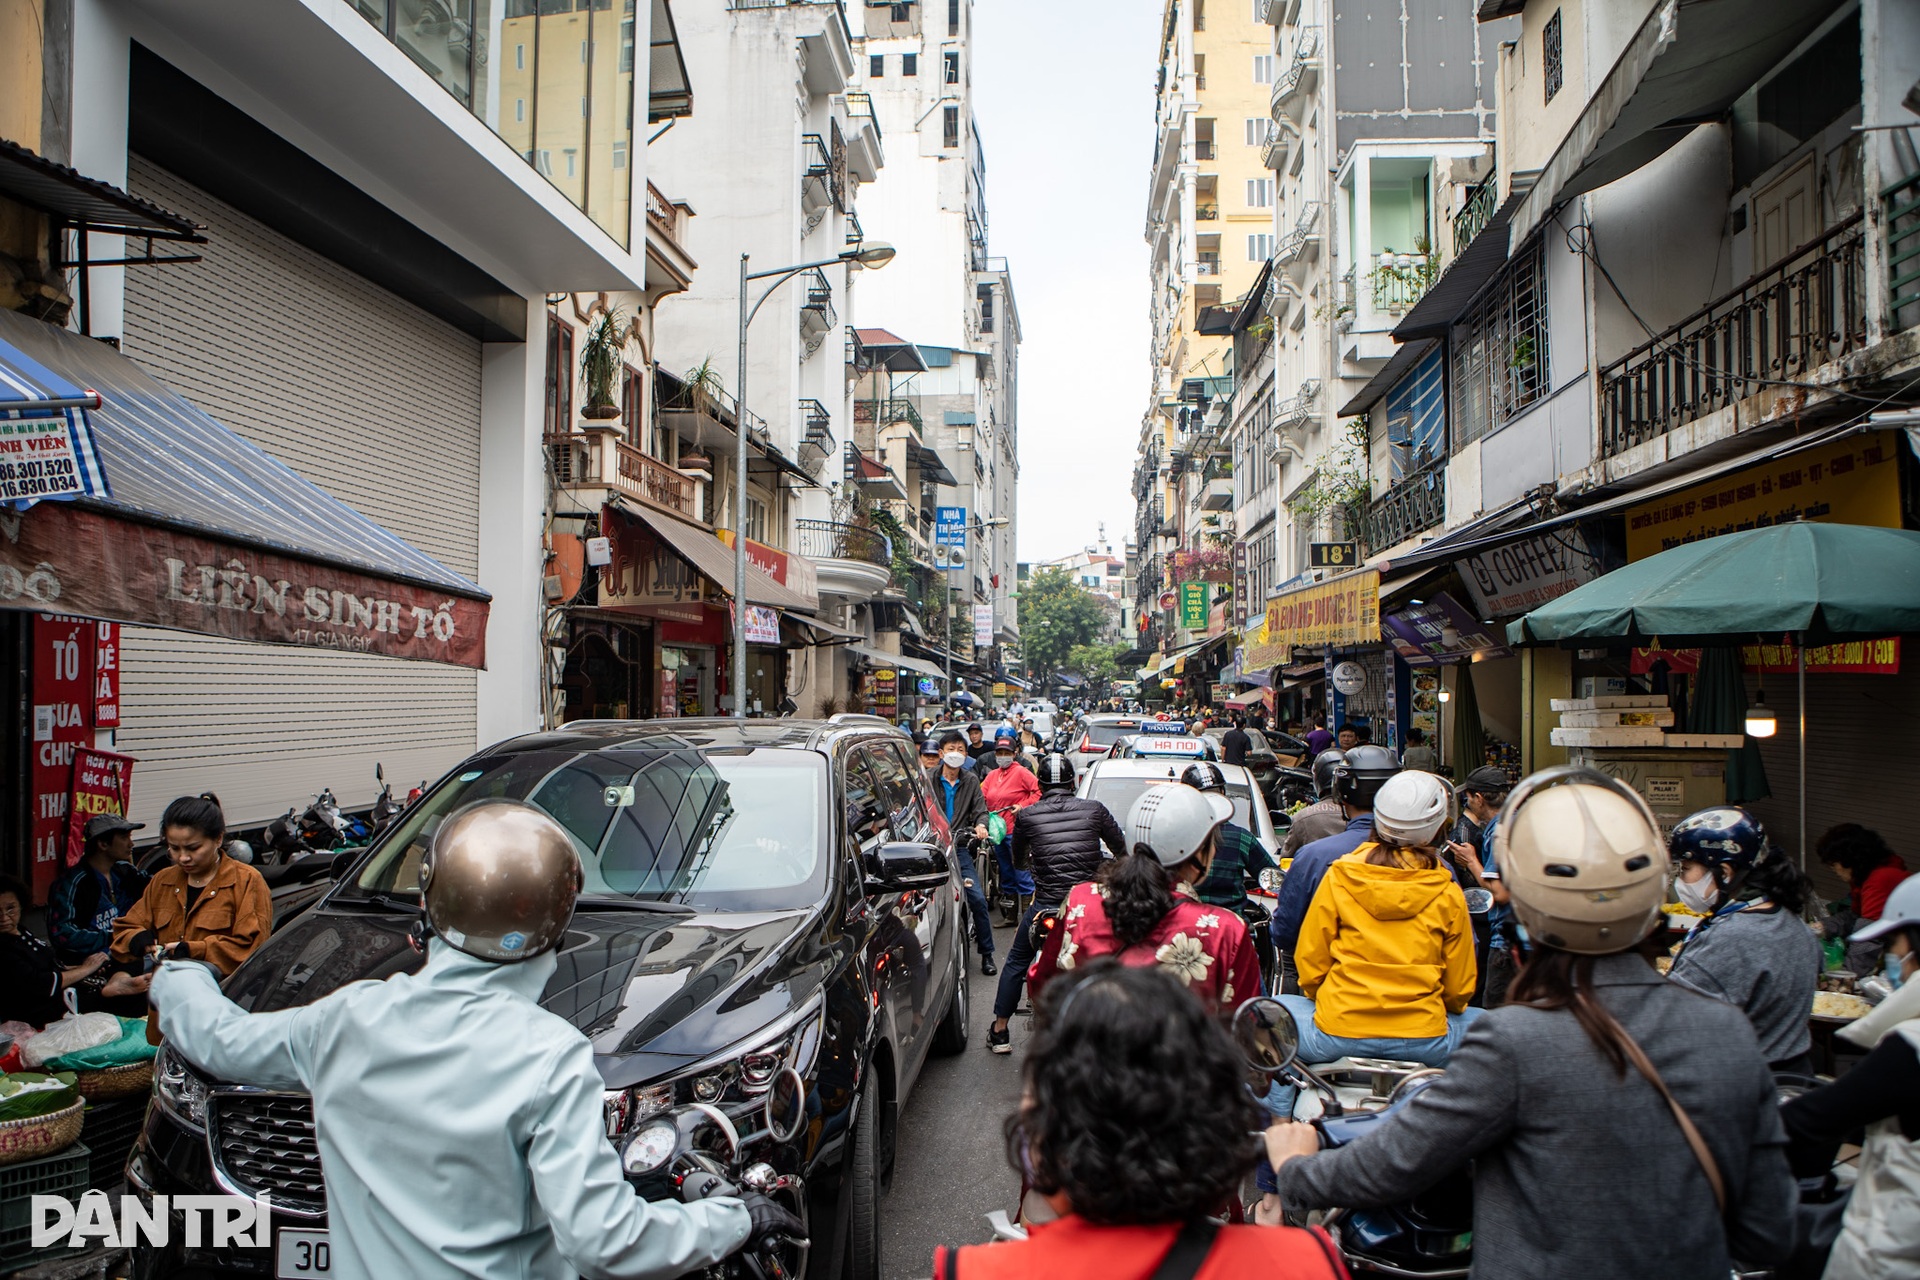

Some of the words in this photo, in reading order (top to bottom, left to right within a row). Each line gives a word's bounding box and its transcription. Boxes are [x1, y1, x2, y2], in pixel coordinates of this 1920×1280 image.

[26, 434, 67, 452] VIÊN
[0, 458, 73, 480] 86.307.520
[0, 475, 78, 498] 16.930.034
[943, 509, 960, 520] NHÀ
[938, 521, 965, 534] THỐC
[1492, 535, 1567, 587] COFFEE
[163, 557, 292, 616] LIÊN
[303, 585, 400, 634] SINH
[410, 599, 455, 641] TỐ
[53, 627, 80, 681] TỐ
[1875, 640, 1895, 664] CON
[82, 770, 100, 787] ĐẶC
[75, 791, 122, 816] KEM
[37, 831, 57, 863] LÁ
[295, 1241, 331, 1271] 30
